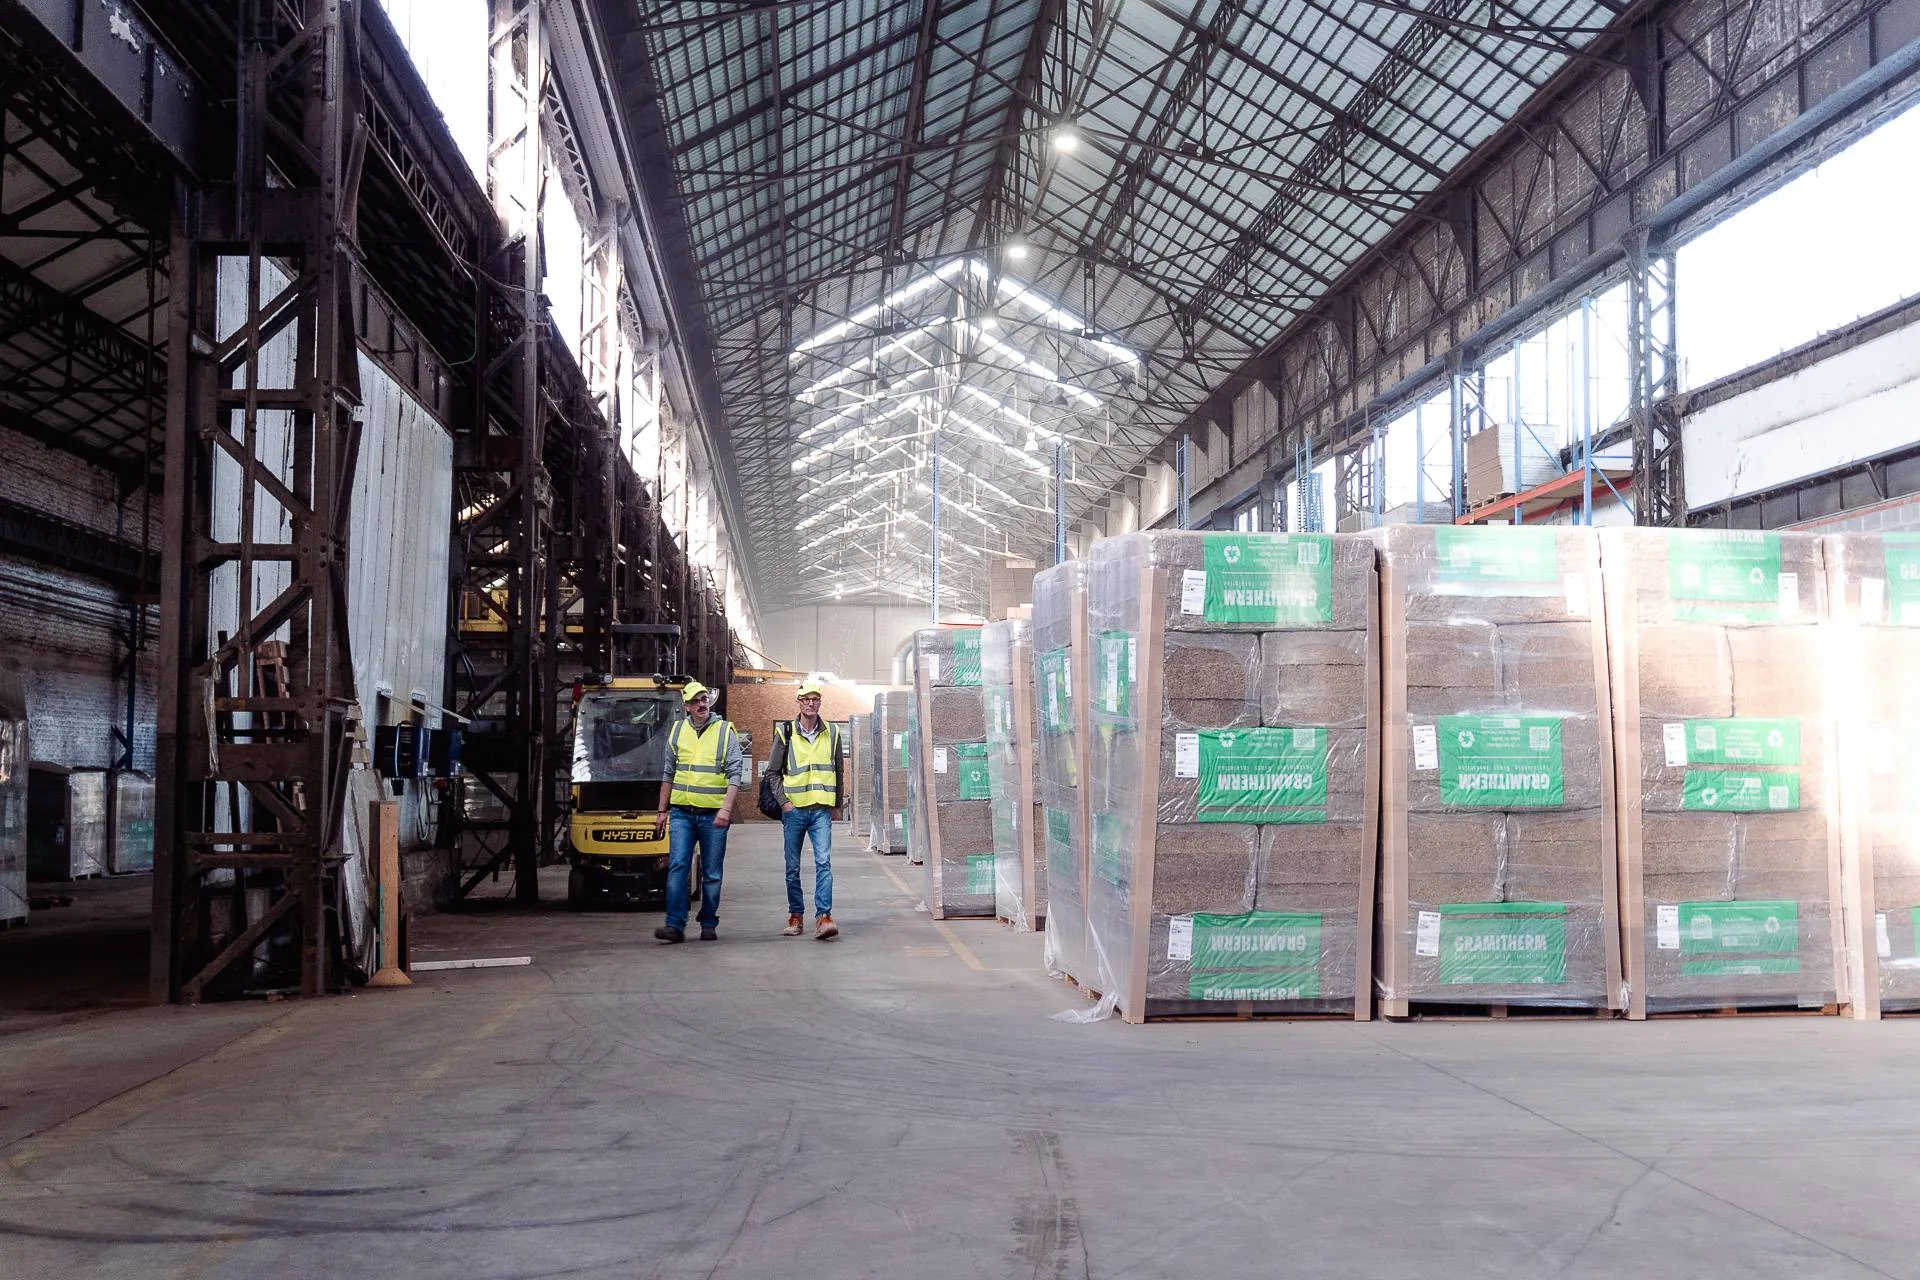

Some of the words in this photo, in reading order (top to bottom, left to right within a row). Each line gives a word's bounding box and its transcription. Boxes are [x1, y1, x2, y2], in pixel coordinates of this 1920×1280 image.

[1217, 774, 1313, 790] GRAMITHERM
[1458, 773, 1550, 790] GRAMITHERM
[601, 830, 654, 841] HYSTER
[1211, 935, 1307, 951] GRAMITHERM
[1455, 934, 1547, 952] GRAMITHERM
